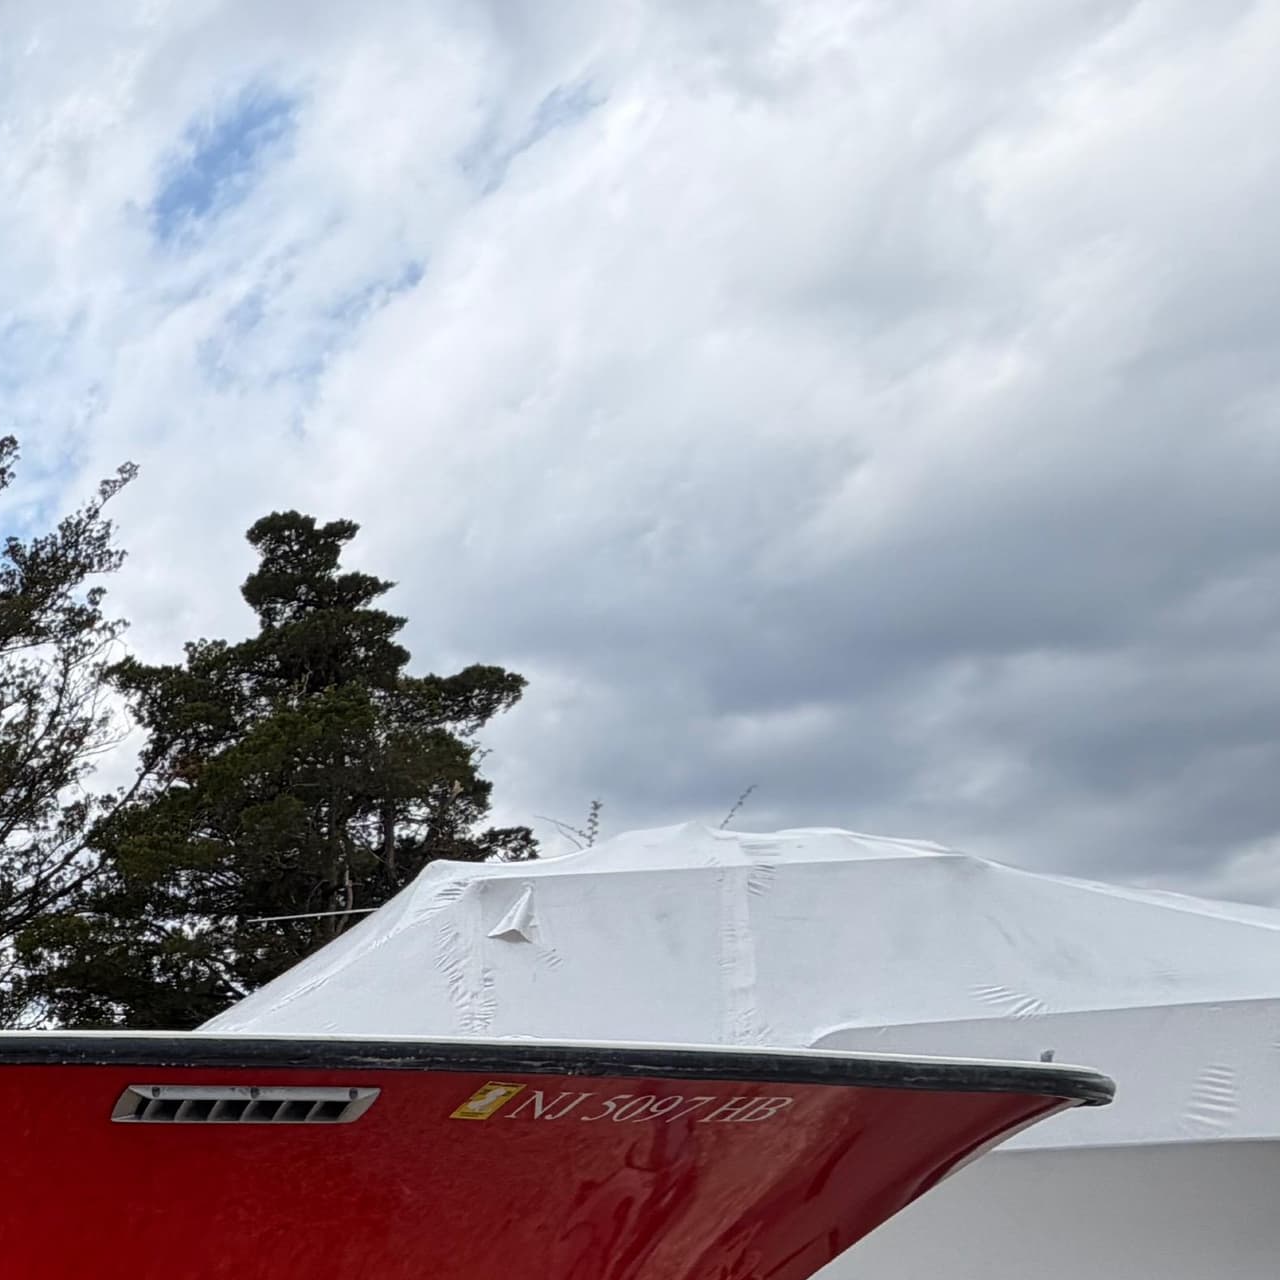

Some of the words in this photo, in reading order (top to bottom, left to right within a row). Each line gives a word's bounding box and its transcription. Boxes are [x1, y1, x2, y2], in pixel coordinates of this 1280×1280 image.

[504, 1090, 593, 1121] NJ
[581, 1094, 716, 1124] 5097
[698, 1096, 793, 1123] HB
